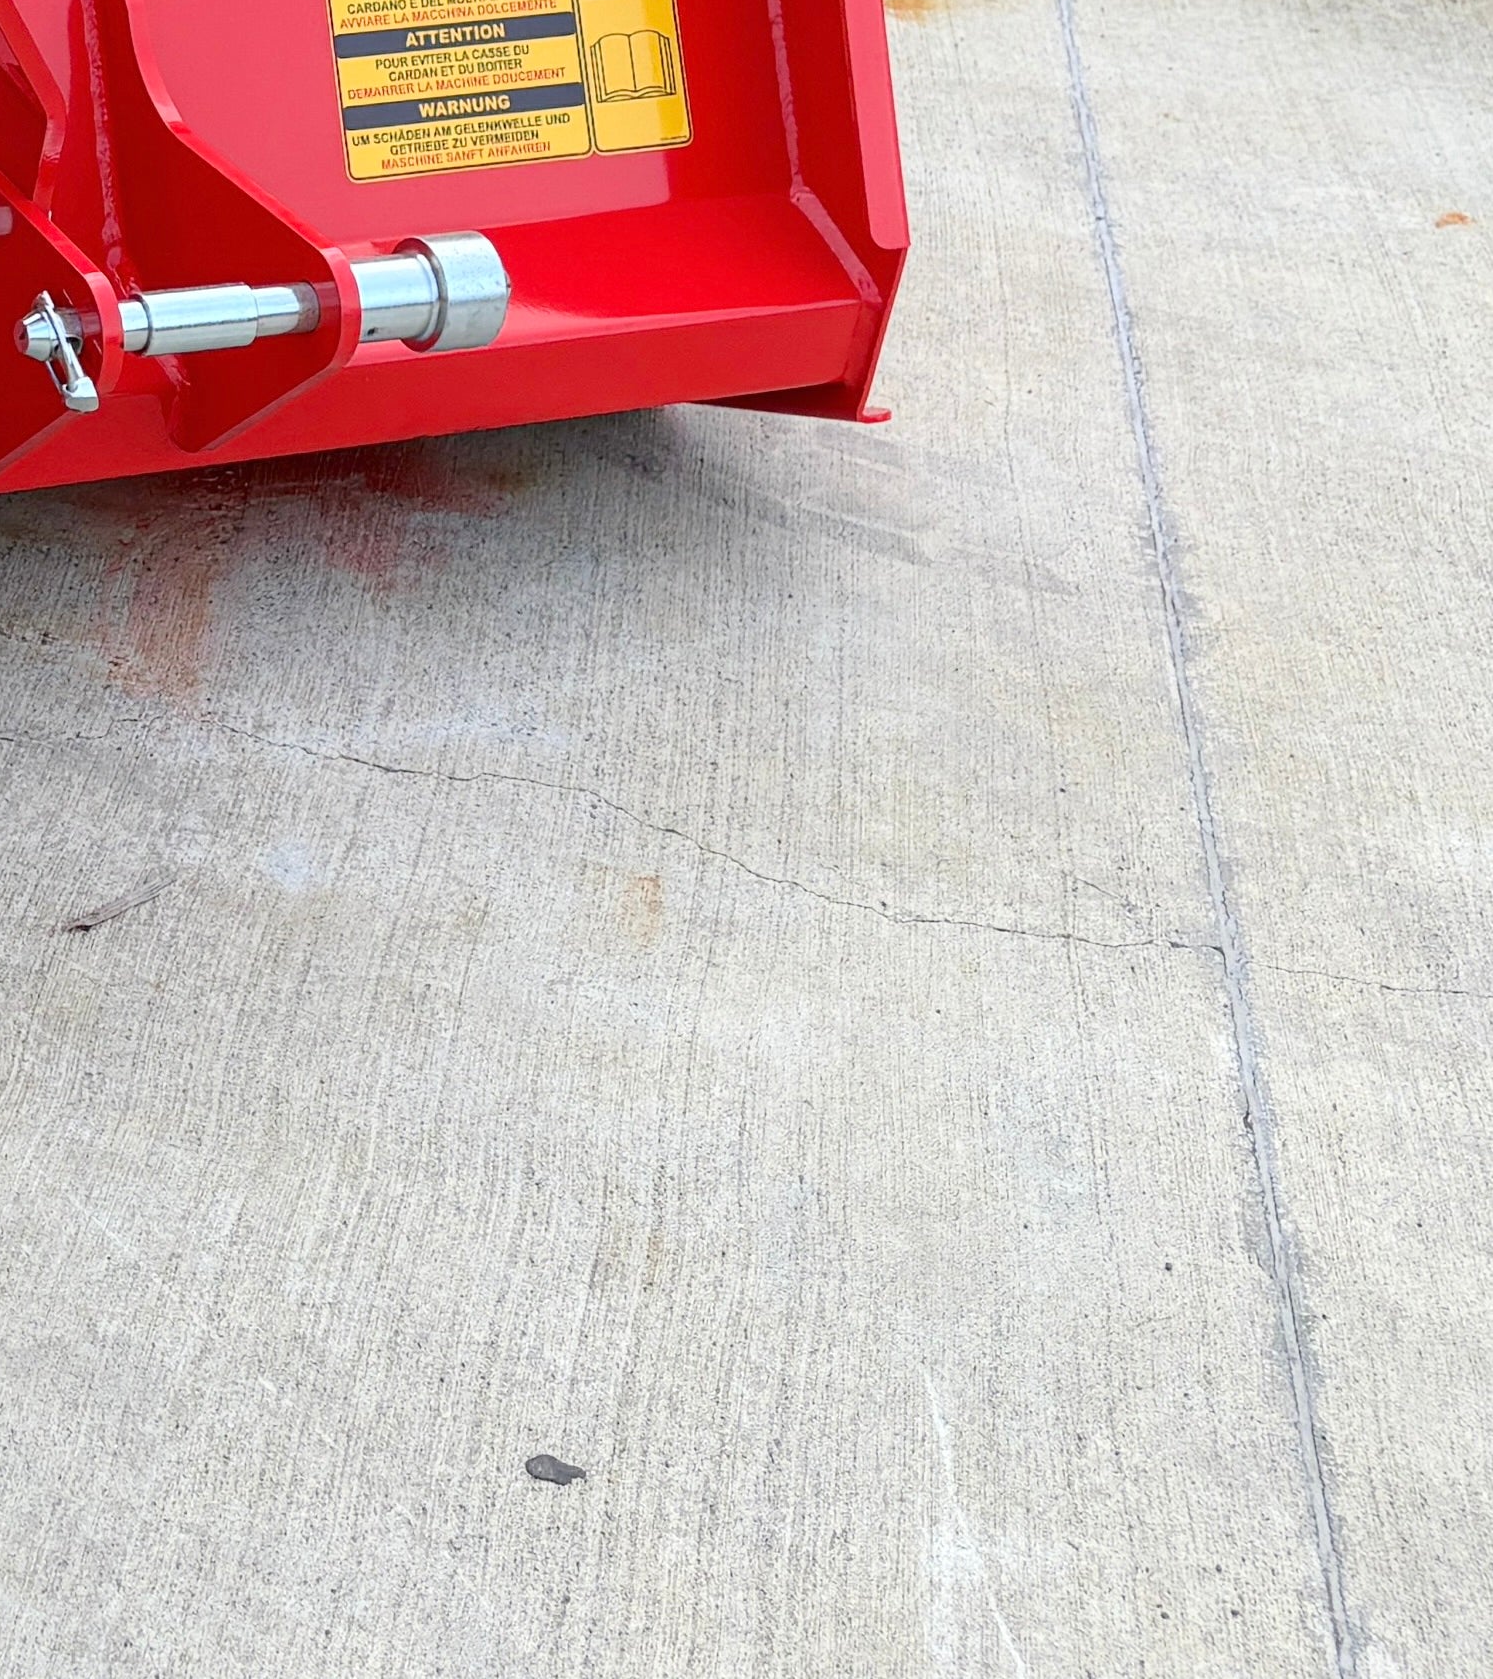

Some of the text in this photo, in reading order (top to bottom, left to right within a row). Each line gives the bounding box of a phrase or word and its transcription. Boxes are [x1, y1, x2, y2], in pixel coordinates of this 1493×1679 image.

[340, 13, 392, 28] AVVIARE
[394, 10, 410, 23] LA
[413, 5, 475, 21] MACCHINA
[347, 0, 406, 14] CARDANO
[405, 23, 505, 48] ATTENTION
[375, 44, 529, 70] POUR EVITER LA CASSE DU
[389, 58, 522, 82] CARDAN ET DU BOITIER
[348, 67, 566, 100] DEMARRER LA MACHINE DOUCEMENT
[419, 95, 511, 118] WARNUNG
[352, 113, 570, 147] UM SCHÄDEN AM GELENKWELLE UND
[390, 130, 539, 155] GETRIEBE ZU VERMEIDEN
[381, 142, 551, 170] MASCHINE SANFT ANFAHREN
